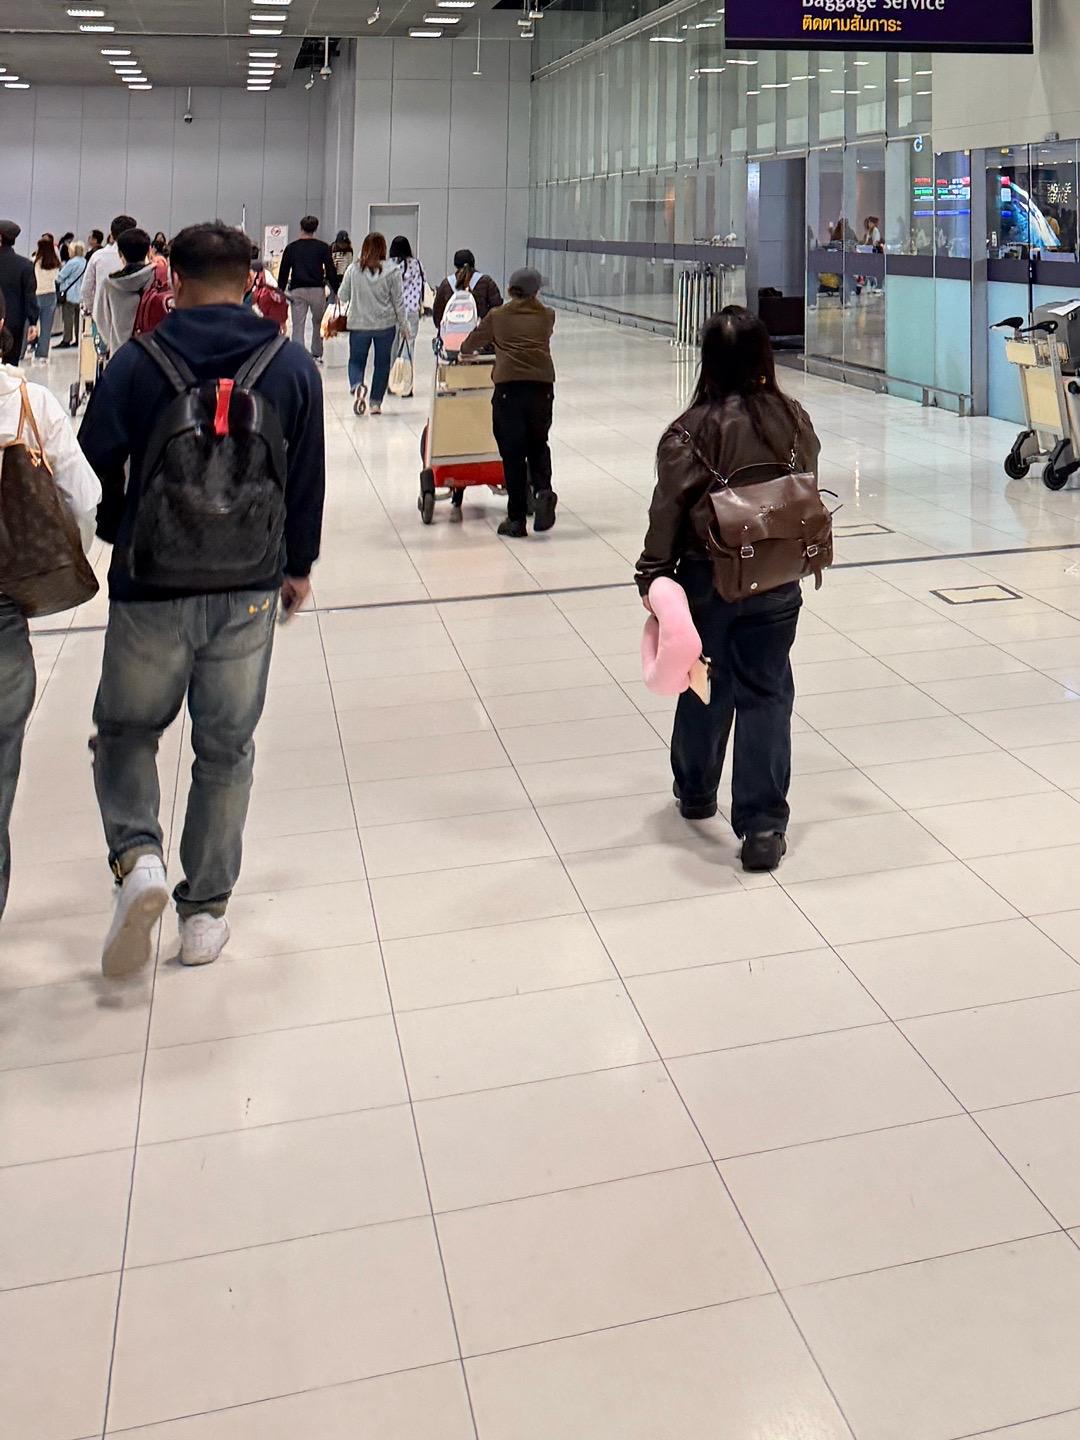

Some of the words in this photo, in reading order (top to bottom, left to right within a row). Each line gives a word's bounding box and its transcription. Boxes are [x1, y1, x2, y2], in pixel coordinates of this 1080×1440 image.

[802, 14, 902, 32] ติดตามสัมภาระ
